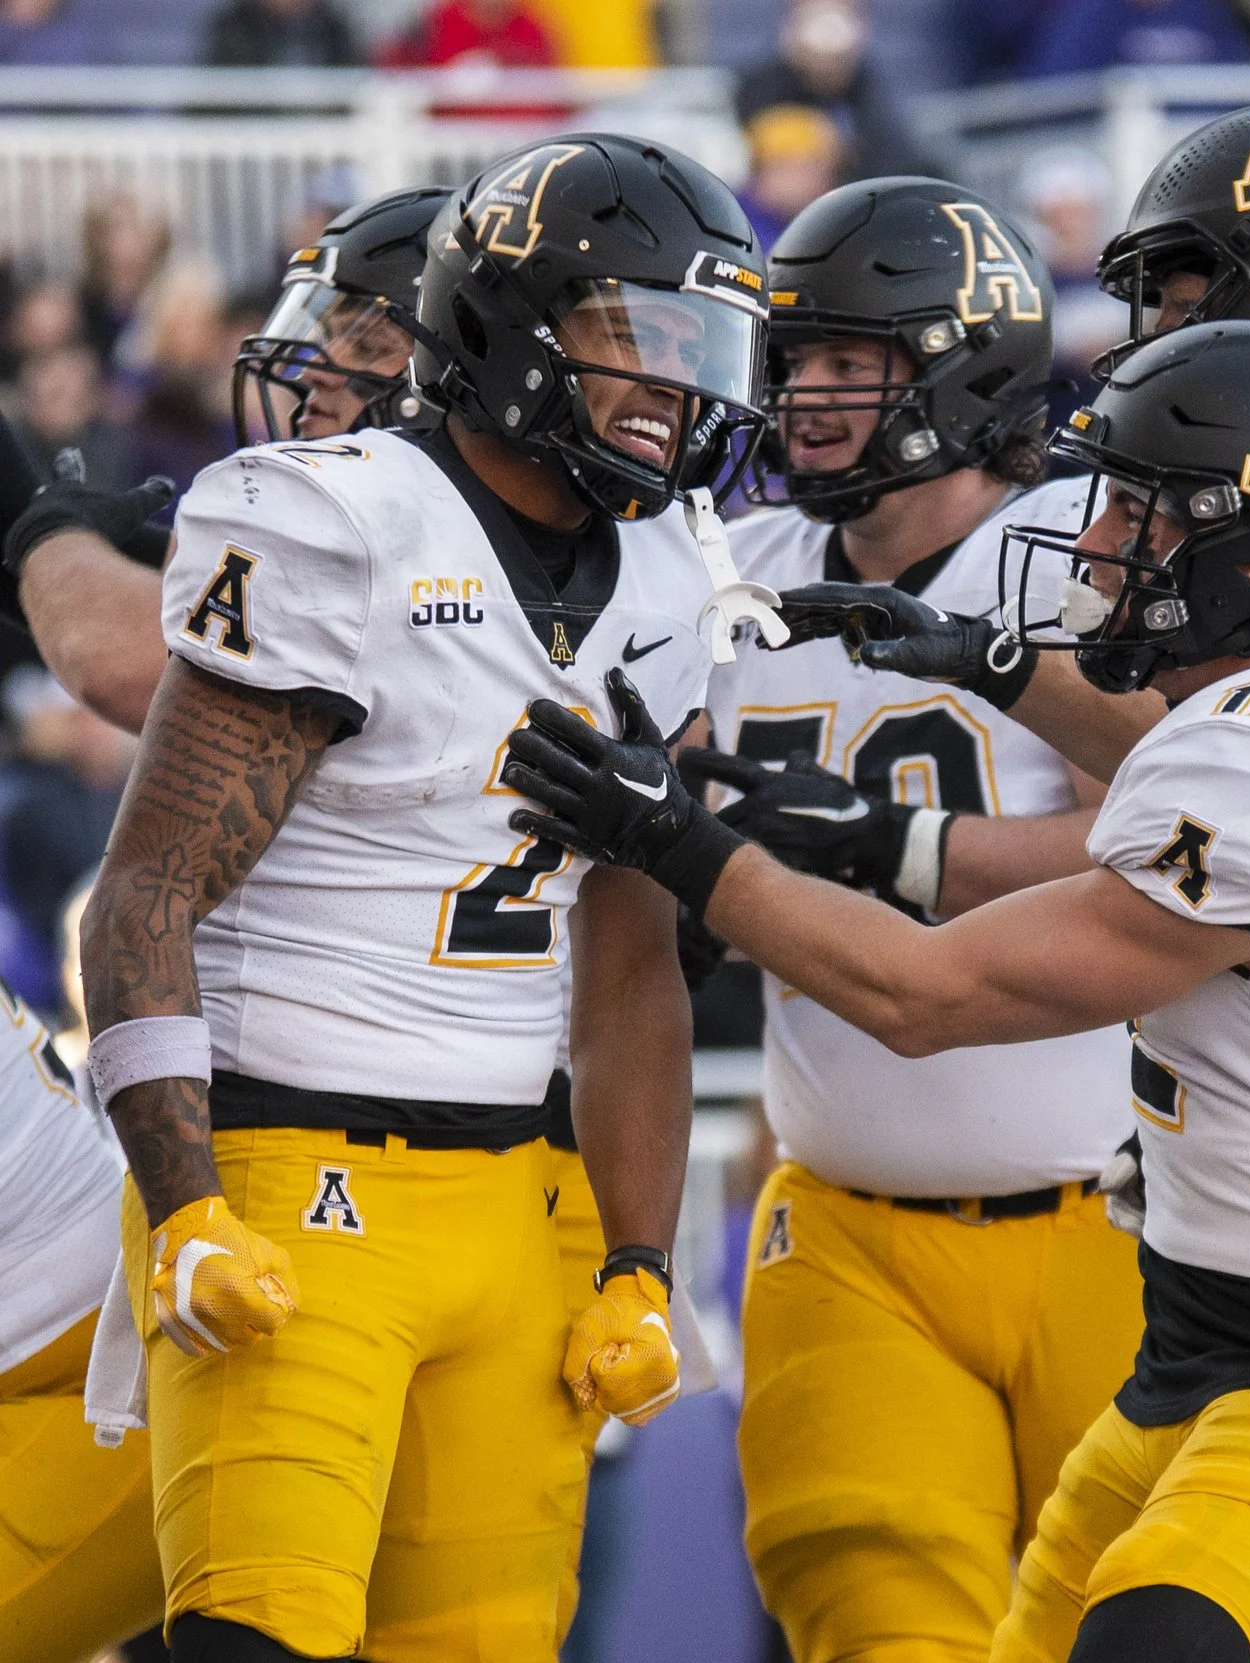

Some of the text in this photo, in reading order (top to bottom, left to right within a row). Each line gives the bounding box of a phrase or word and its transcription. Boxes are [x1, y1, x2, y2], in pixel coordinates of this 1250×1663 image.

[940, 203, 1043, 325] A
[183, 545, 257, 661] A
[411, 577, 484, 627] SBC
[303, 1164, 365, 1236] A
